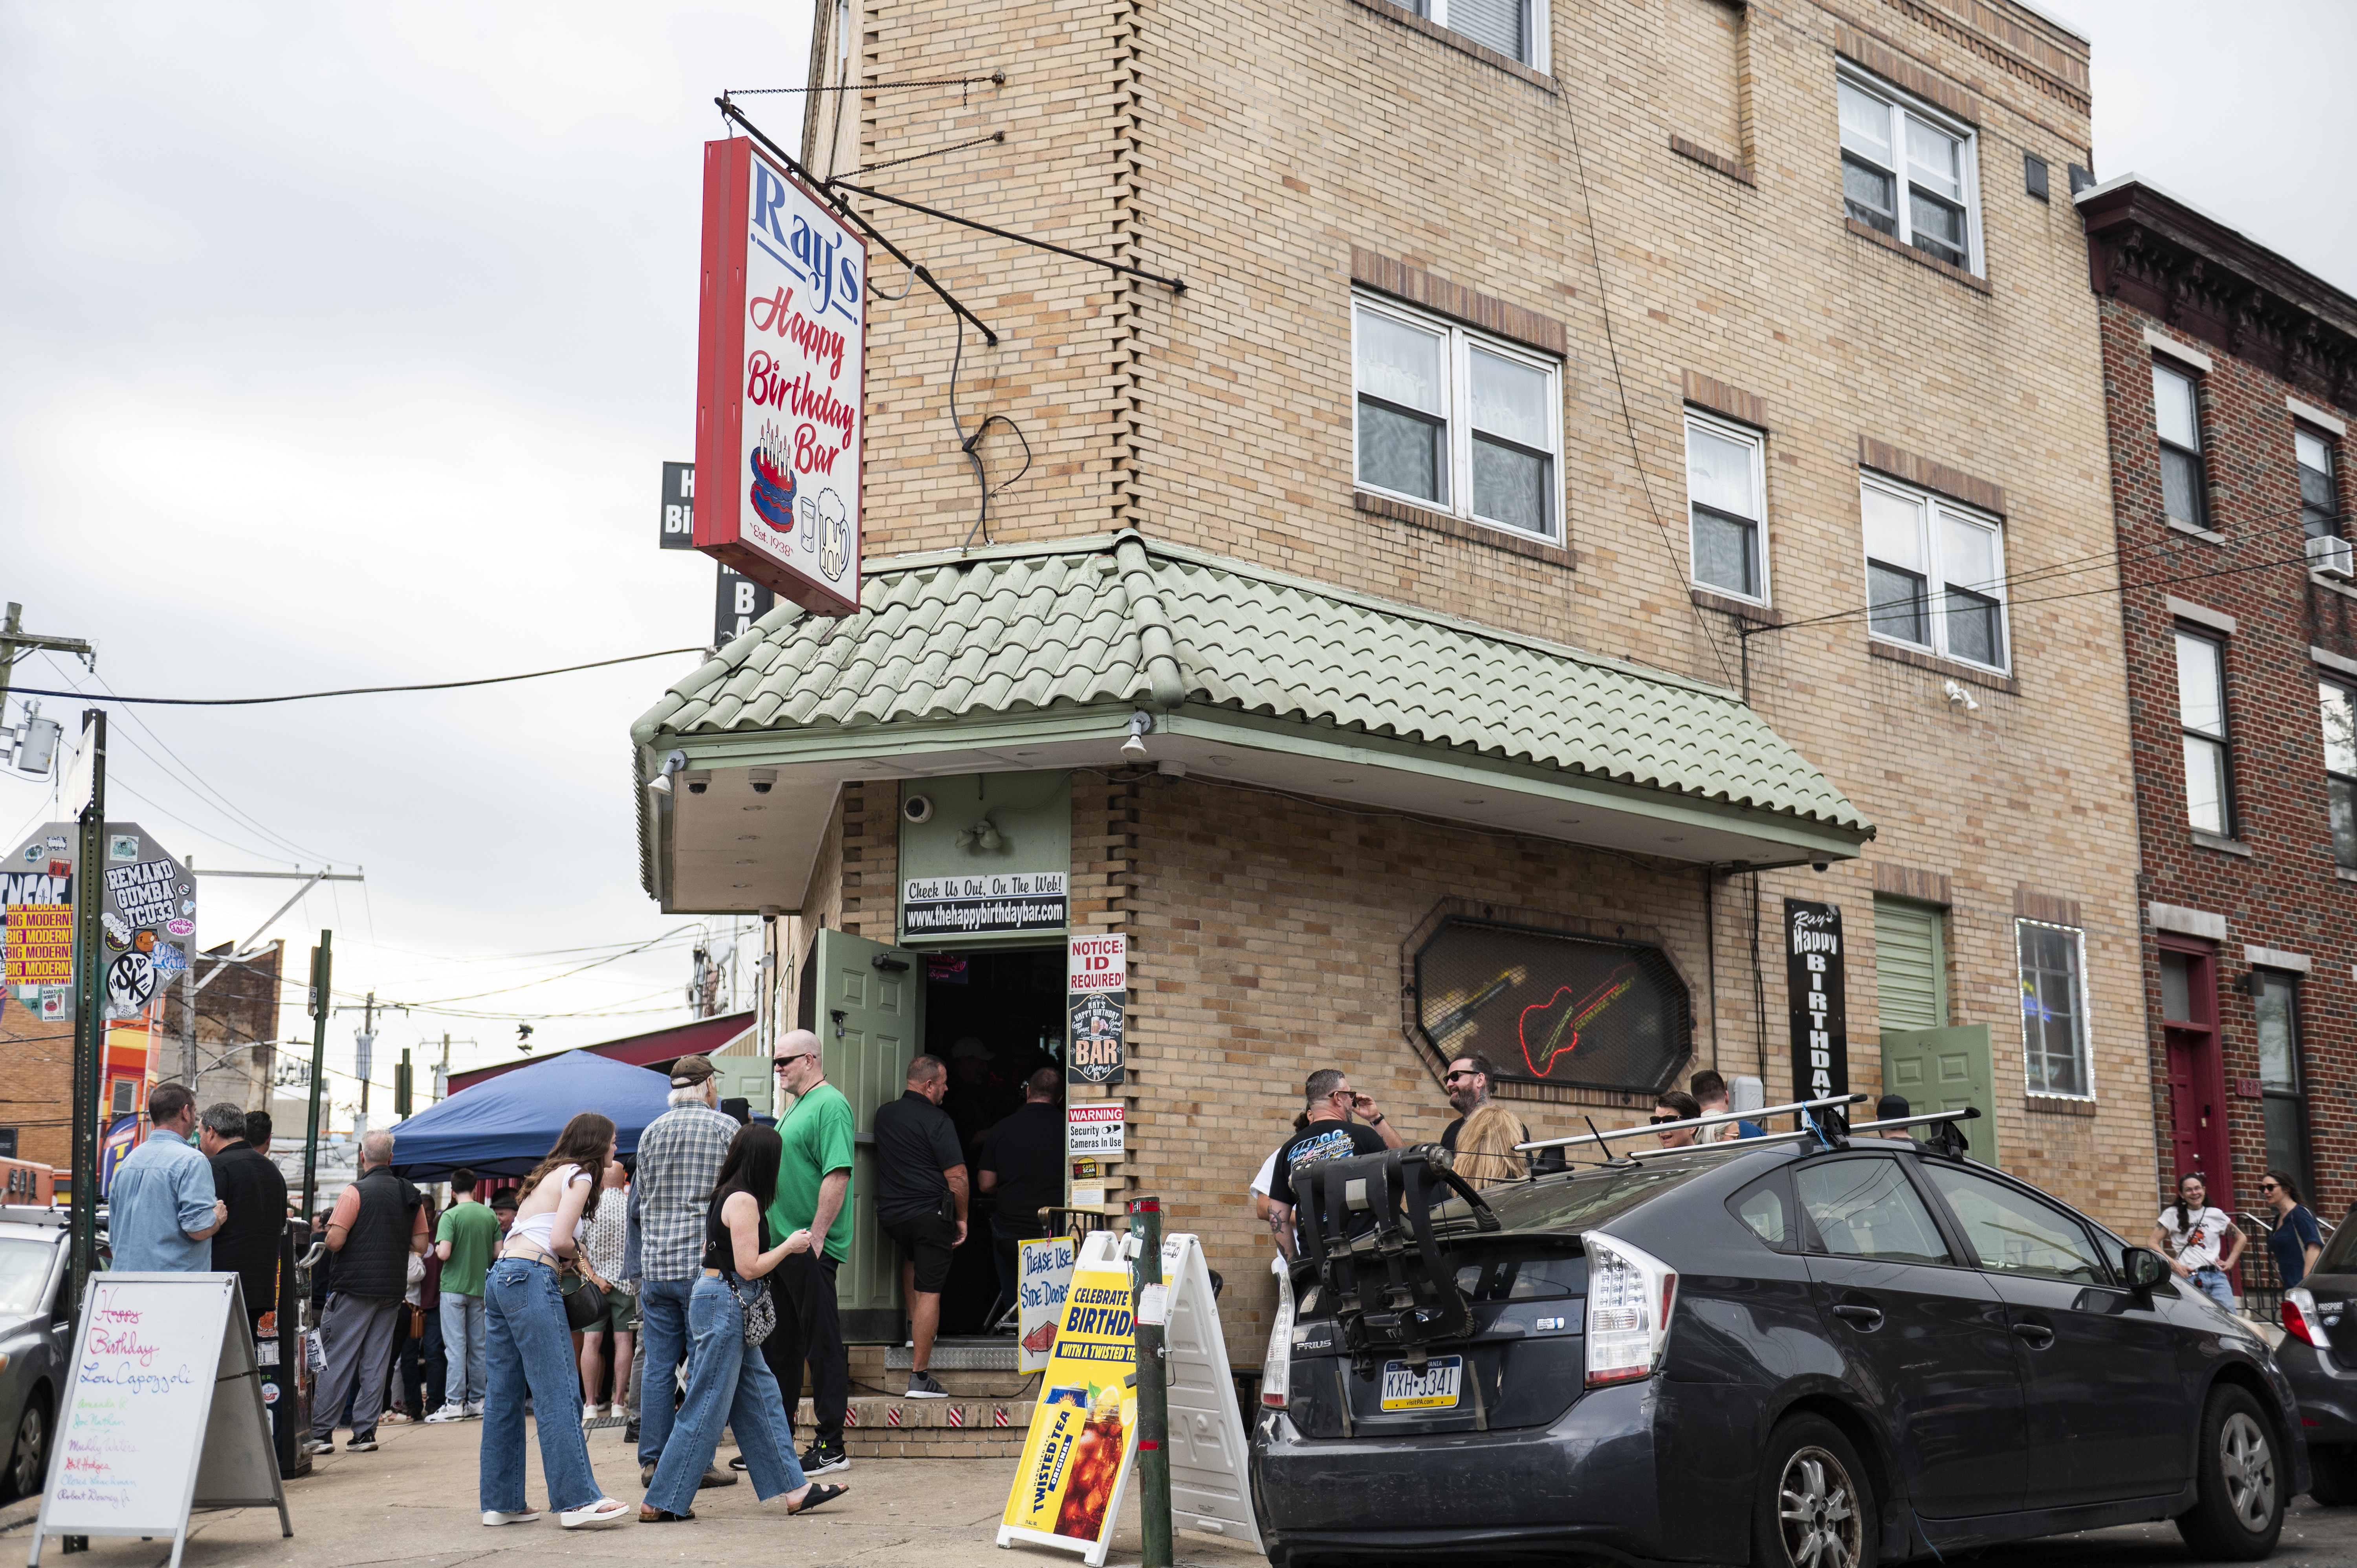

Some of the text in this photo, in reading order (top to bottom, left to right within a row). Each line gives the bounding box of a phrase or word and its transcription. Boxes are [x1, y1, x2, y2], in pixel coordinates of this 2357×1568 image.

[751, 158, 858, 314] Ray's
[750, 286, 845, 380] Happy
[748, 350, 855, 450] Birthday
[794, 423, 839, 476] Bar
[106, 860, 175, 890] REMAND
[117, 880, 175, 908] GUMBA
[909, 876, 1062, 899] Check Us Out, On The Web!
[6, 912, 73, 926] BIG MODERN!
[124, 900, 175, 927] TCU33
[907, 900, 1063, 930] www.thehappybirthdaybar.com
[1794, 910, 1836, 928] Ray's
[169, 919, 194, 929] praise
[171, 925, 194, 934] dobler
[7, 929, 72, 943] BIG MODERN!
[1793, 925, 1837, 955] Happy
[6, 946, 22, 958] BIG
[26, 945, 72, 958] MODERN!
[1072, 940, 1123, 956] NOTICE:
[5, 961, 71, 975] BIG MODERN!
[1086, 956, 1109, 971] ID
[1071, 972, 1124, 989] REQUIRED!
[1088, 1001, 1106, 1010] RAY'S
[1072, 1019, 1083, 1029] Good
[1074, 1009, 1120, 1022] HAPPY BIRTHDAY
[1109, 1018, 1123, 1027] Great
[1076, 1026, 1090, 1035] Times
[1108, 1025, 1122, 1033] Friends
[1076, 1039, 1118, 1065] BAR
[1087, 1064, 1107, 1075] Cheers
[2242, 1080, 2260, 1095] 832
[1070, 1109, 1123, 1121] WARNING
[1070, 1125, 1099, 1136] Security
[1070, 1138, 1122, 1149] Cameras In Use
[1023, 1246, 1074, 1276] PLEASE USE
[1021, 1280, 1070, 1309] SIDE DOORS
[1074, 1288, 1129, 1306] CELEBRATE
[95, 1287, 143, 1324] Happy
[2318, 1302, 2344, 1311] PROSPORT
[90, 1328, 160, 1367] Birthday
[1061, 1343, 1083, 1357] WITH
[1082, 1345, 1088, 1357] A
[1090, 1345, 1125, 1360] TWISTED
[1297, 1339, 1331, 1350] PRIUS
[80, 1362, 114, 1383] Lou
[88, 1413, 125, 1427] Nathan
[68, 1435, 101, 1462] Muddy
[81, 1455, 112, 1475] Hodges
[1033, 1410, 1070, 1513] TWISTED TEA
[1051, 1441, 1070, 1485] ORIGINAL
